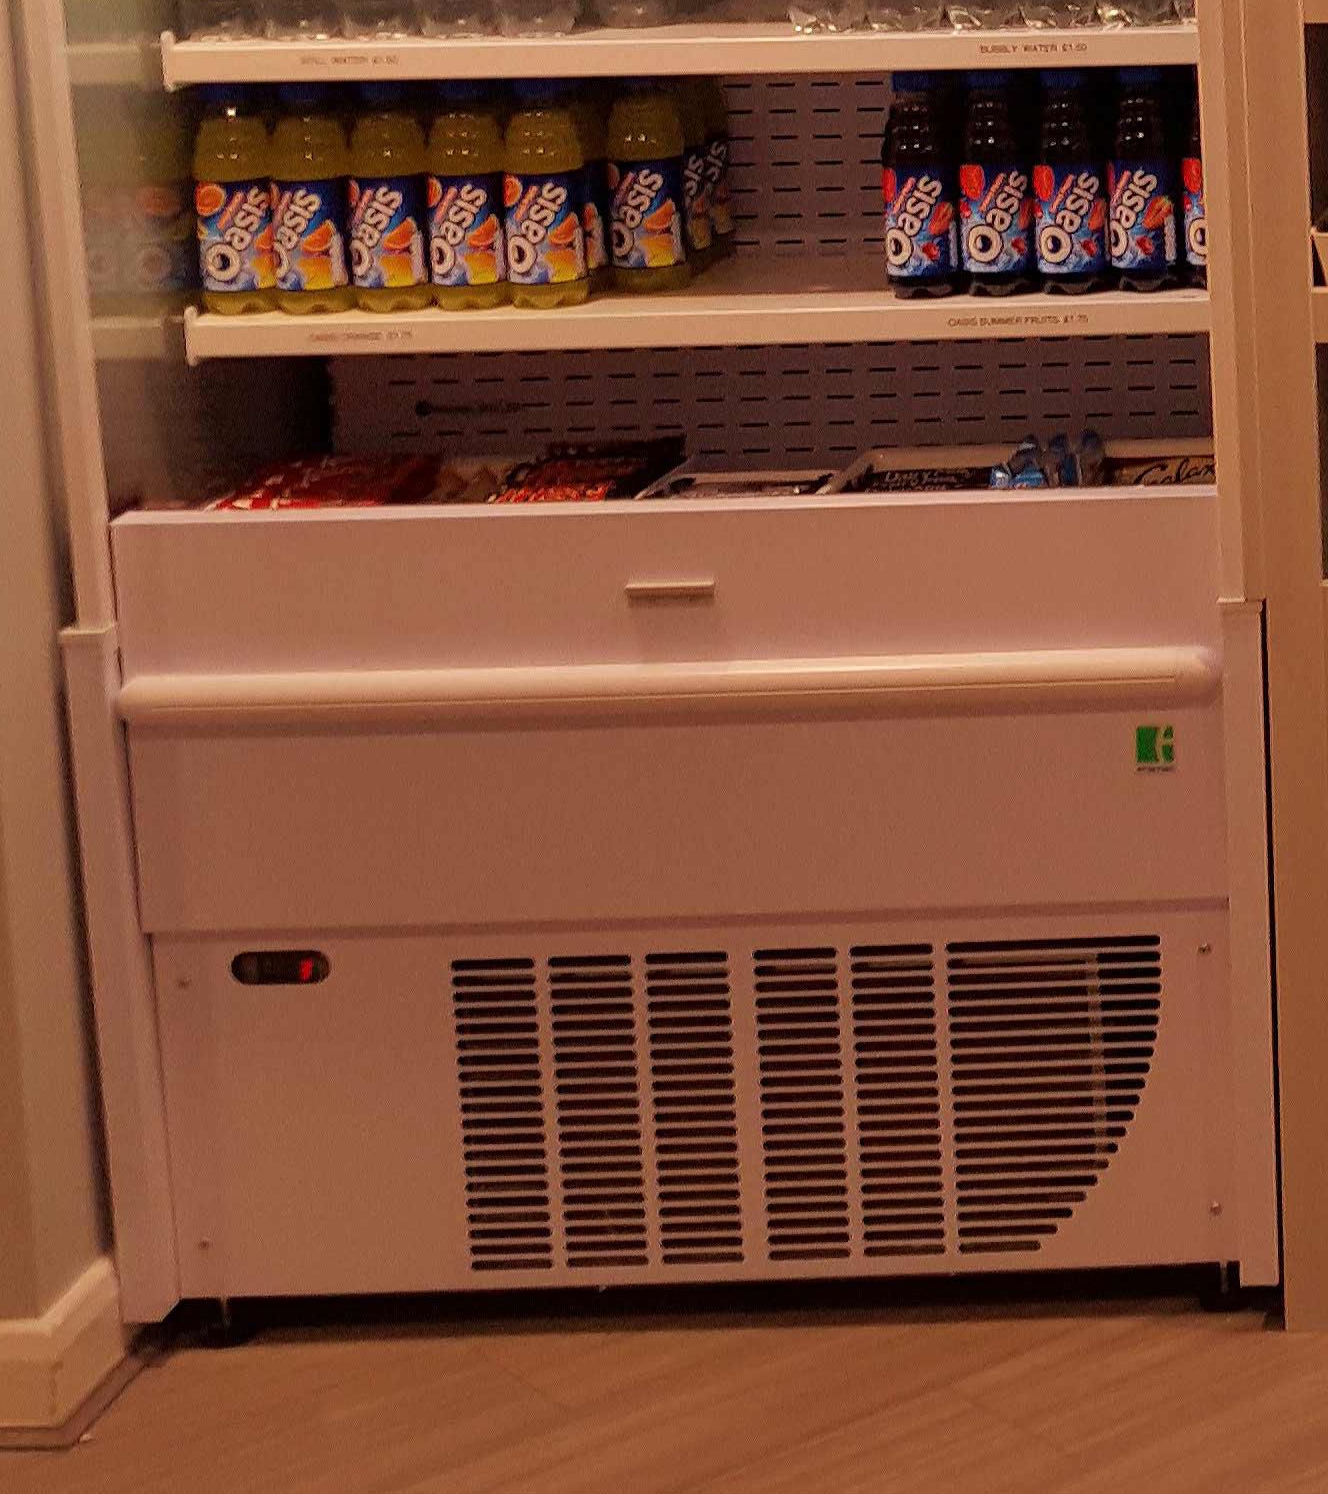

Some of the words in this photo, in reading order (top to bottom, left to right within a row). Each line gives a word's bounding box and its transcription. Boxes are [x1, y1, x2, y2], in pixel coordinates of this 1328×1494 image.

[205, 186, 269, 282] Oasis
[351, 186, 403, 278] Oasis
[430, 182, 488, 277] Oasis
[507, 181, 568, 275] Oasis
[611, 168, 665, 258] Oasis
[885, 175, 943, 267] Oasis
[967, 170, 1029, 264] Oasis
[1037, 170, 1100, 264] Oasis
[1109, 168, 1158, 258] Oasis
